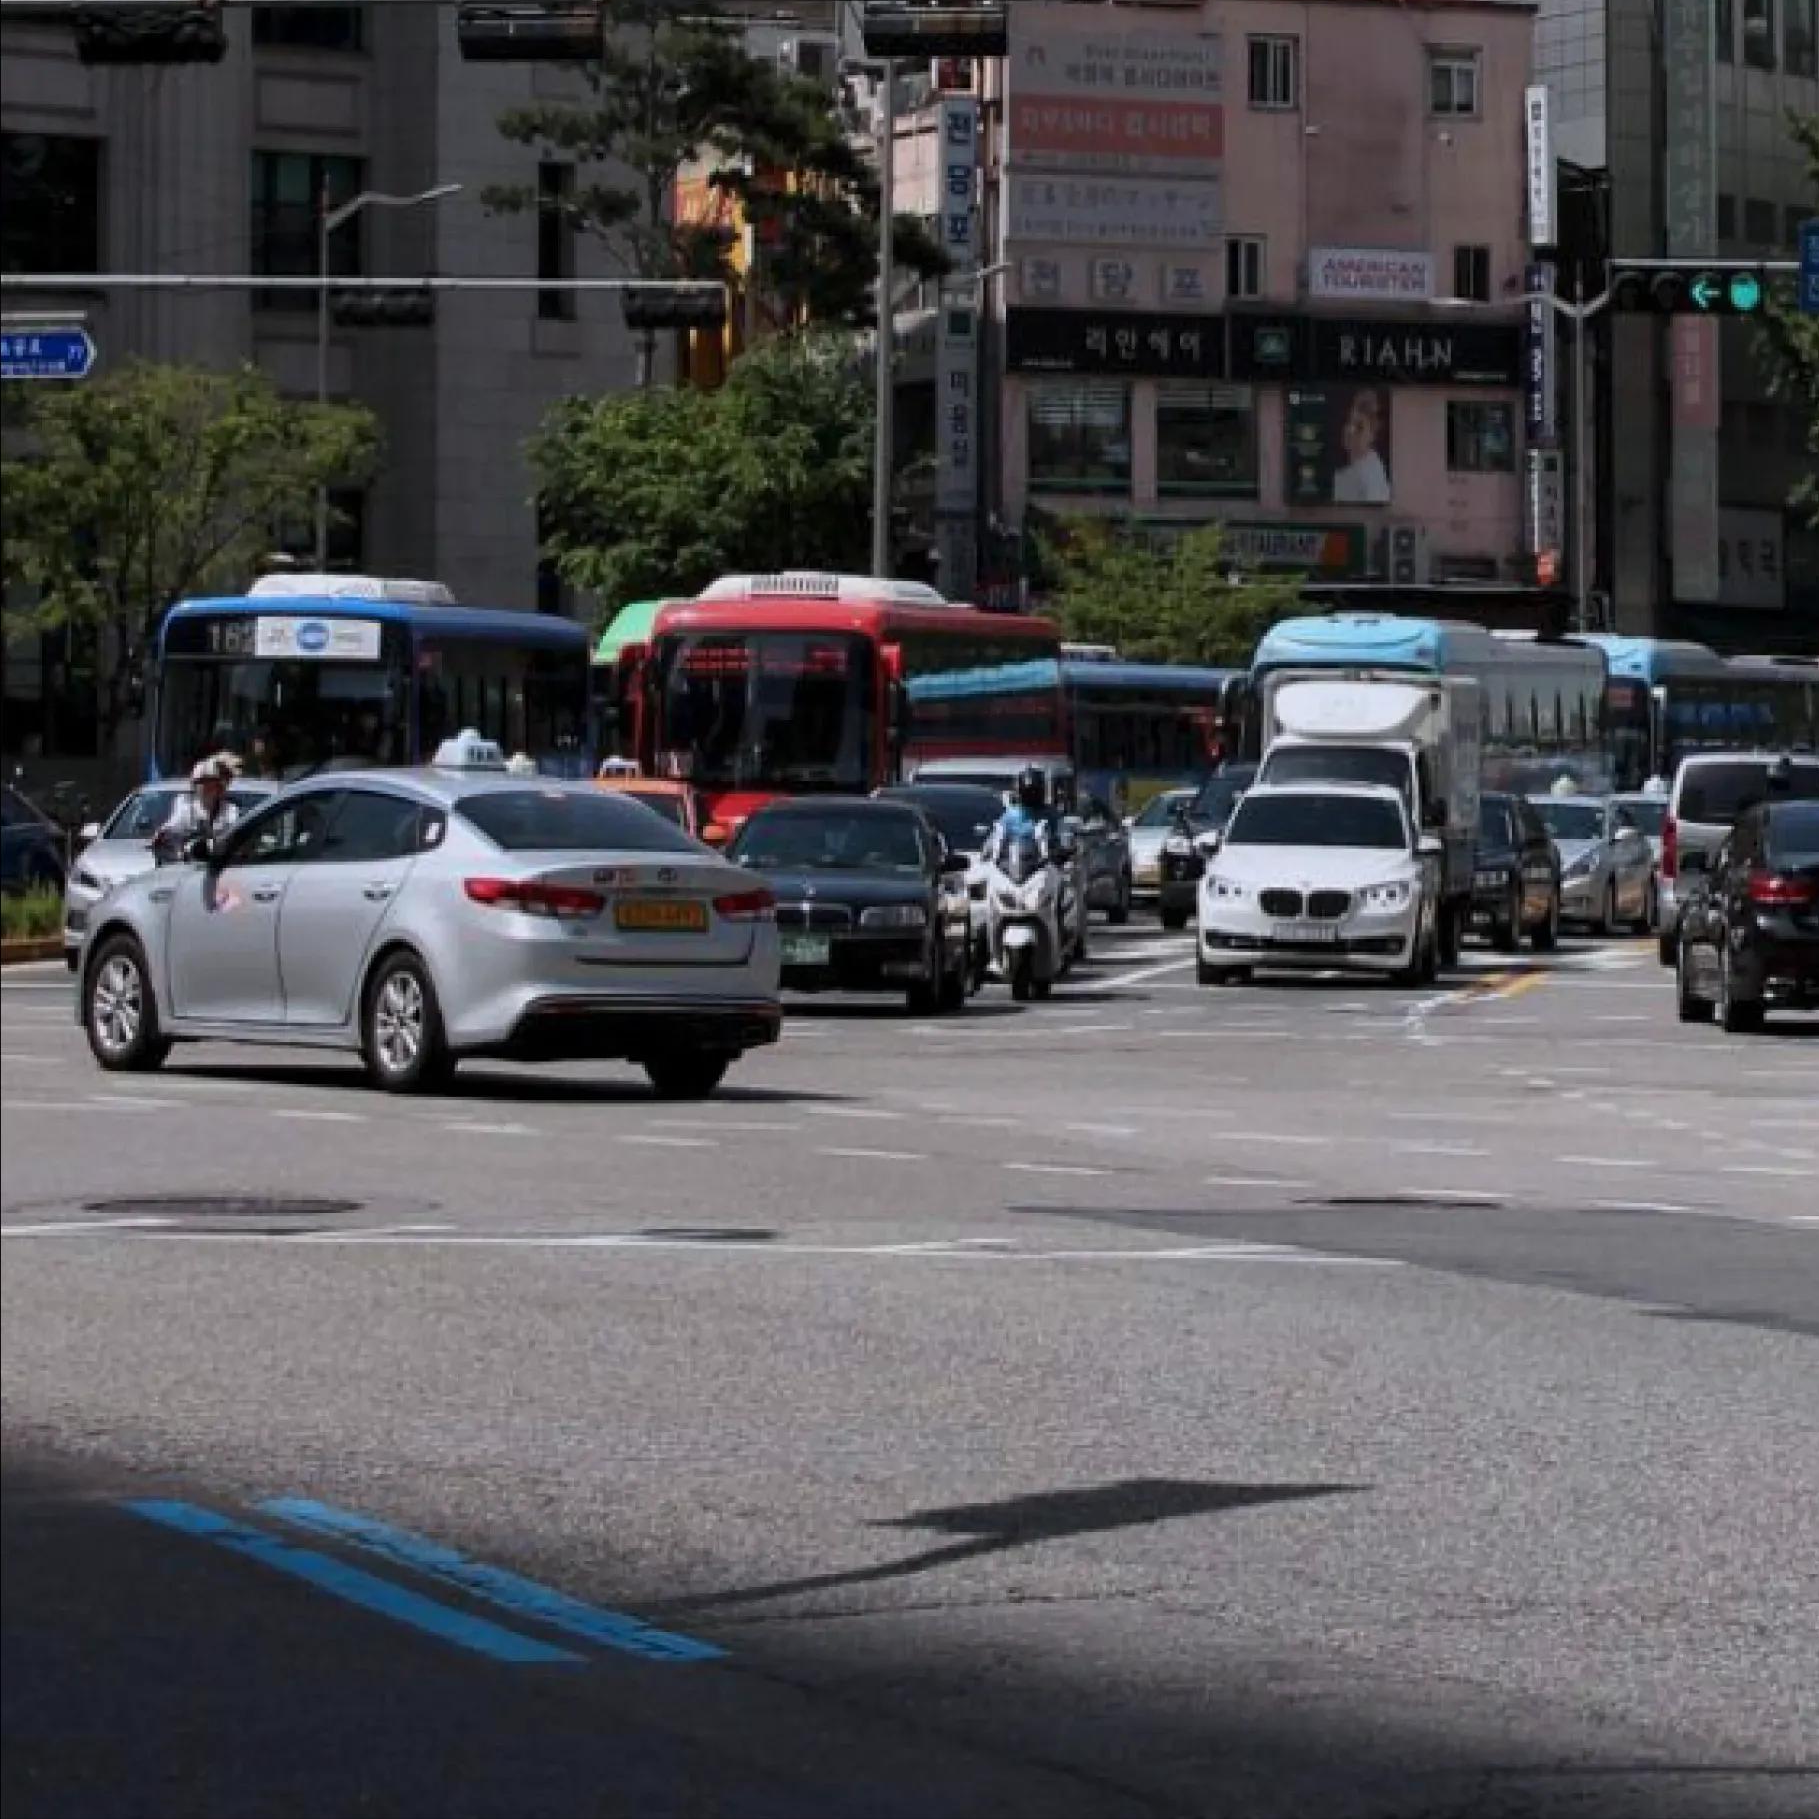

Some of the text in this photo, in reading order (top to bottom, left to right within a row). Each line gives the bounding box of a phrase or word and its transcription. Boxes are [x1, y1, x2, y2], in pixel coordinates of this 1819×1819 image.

[1322, 257, 1426, 275] AMERICAN
[1085, 327, 1203, 360] 리안헤어
[1339, 335, 1453, 367] RIAHN
